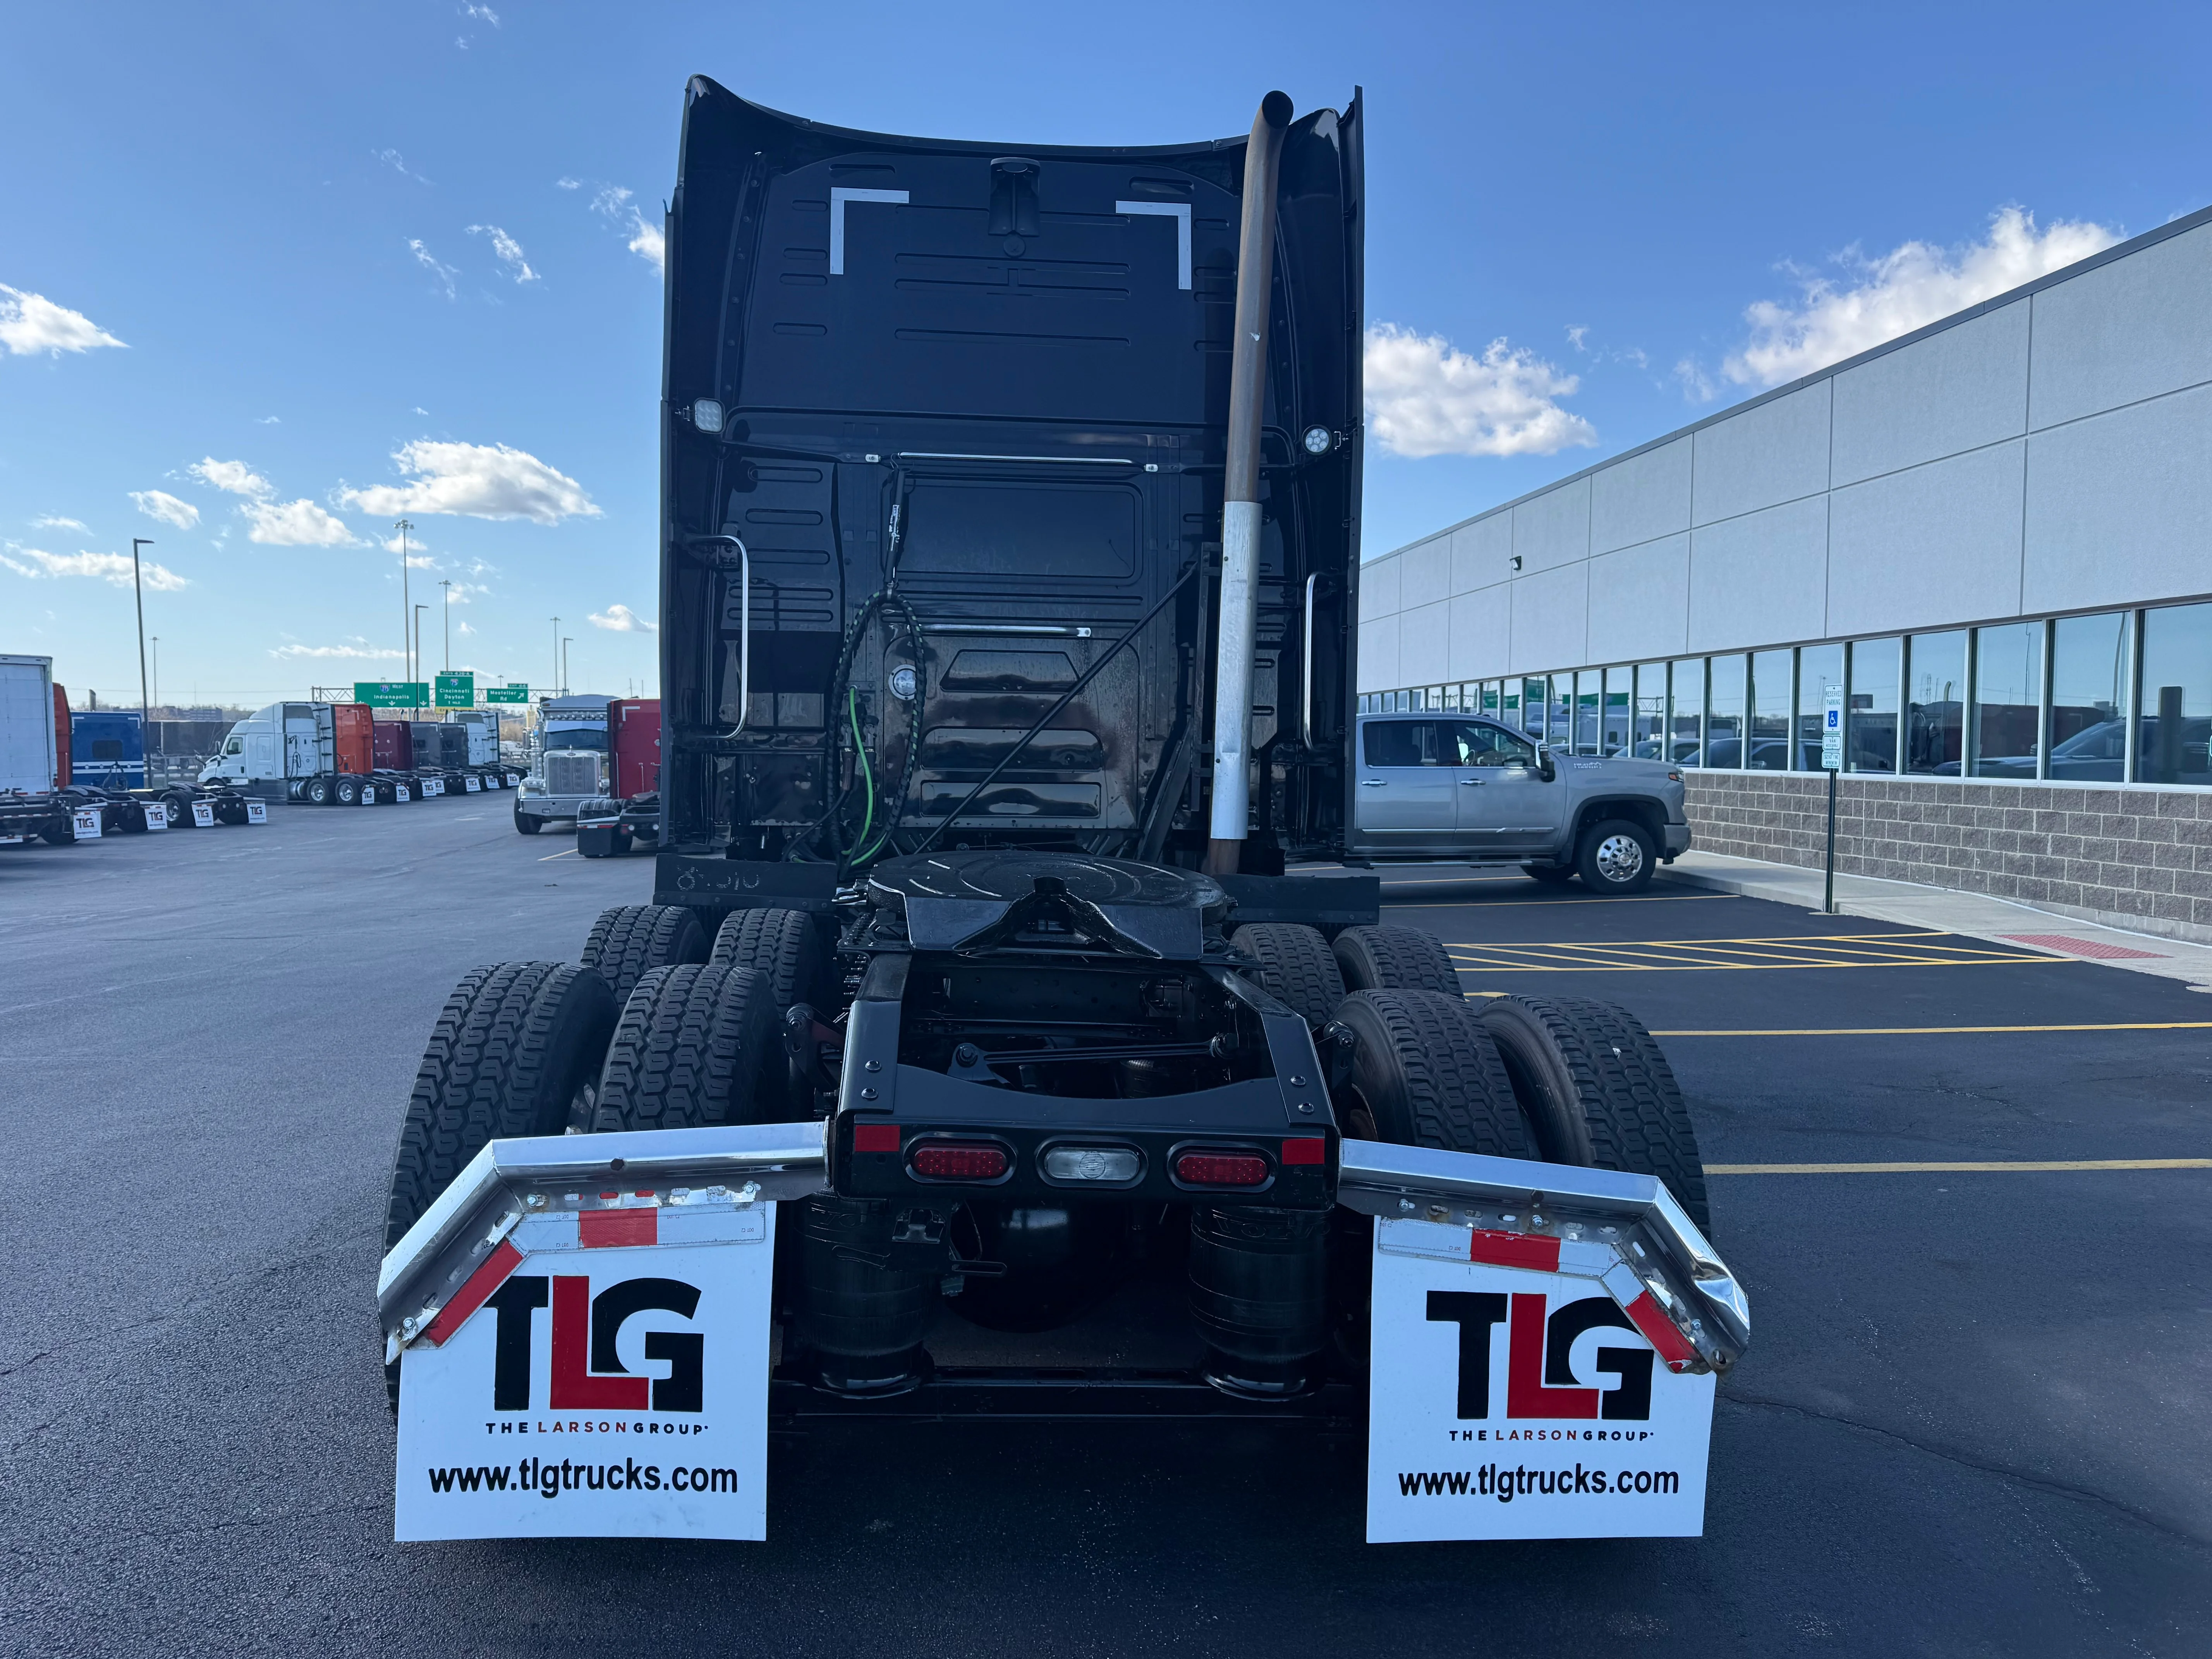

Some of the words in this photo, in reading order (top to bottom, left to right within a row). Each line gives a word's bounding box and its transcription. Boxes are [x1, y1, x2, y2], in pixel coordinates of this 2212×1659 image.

[149, 812, 163, 821] TLG
[196, 809, 209, 818] TLG
[250, 806, 263, 815] TLG
[76, 817, 94, 828] TLG
[483, 1275, 704, 1412] TLG
[1426, 1290, 1655, 1420] TLG
[486, 1422, 528, 1434] THE
[538, 1421, 626, 1433] LARSON
[1449, 1430, 1487, 1441] THE
[1496, 1430, 1576, 1441] LARSON
[429, 1457, 737, 1499] www.tlgtrucks.com
[1398, 1463, 1679, 1503] www.tlgtrucks.com
